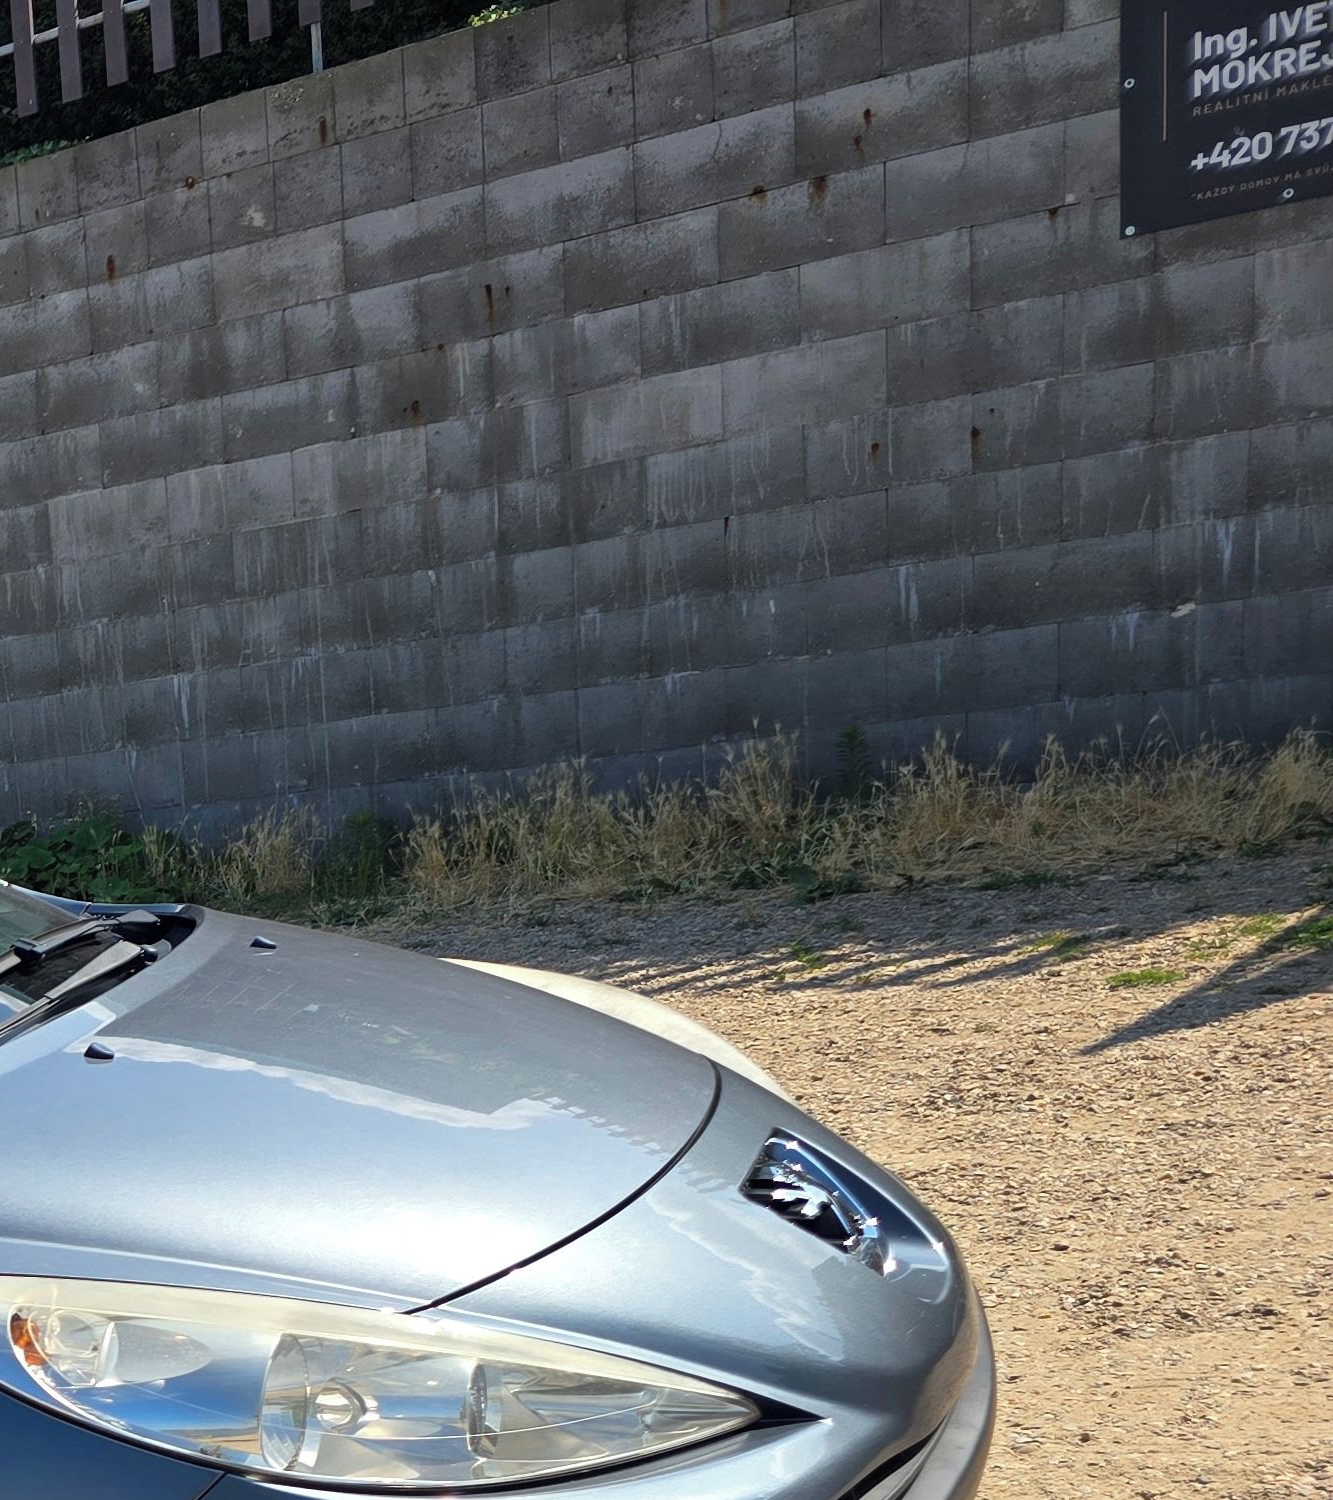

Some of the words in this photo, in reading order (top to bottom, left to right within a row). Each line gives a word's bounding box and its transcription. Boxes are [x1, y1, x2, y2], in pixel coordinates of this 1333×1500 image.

[1193, 26, 1258, 60] Ing.
[1268, 0, 1333, 42] IVE
[1193, 88, 1269, 117] REALITNÍ
[1190, 131, 1273, 171] +420
